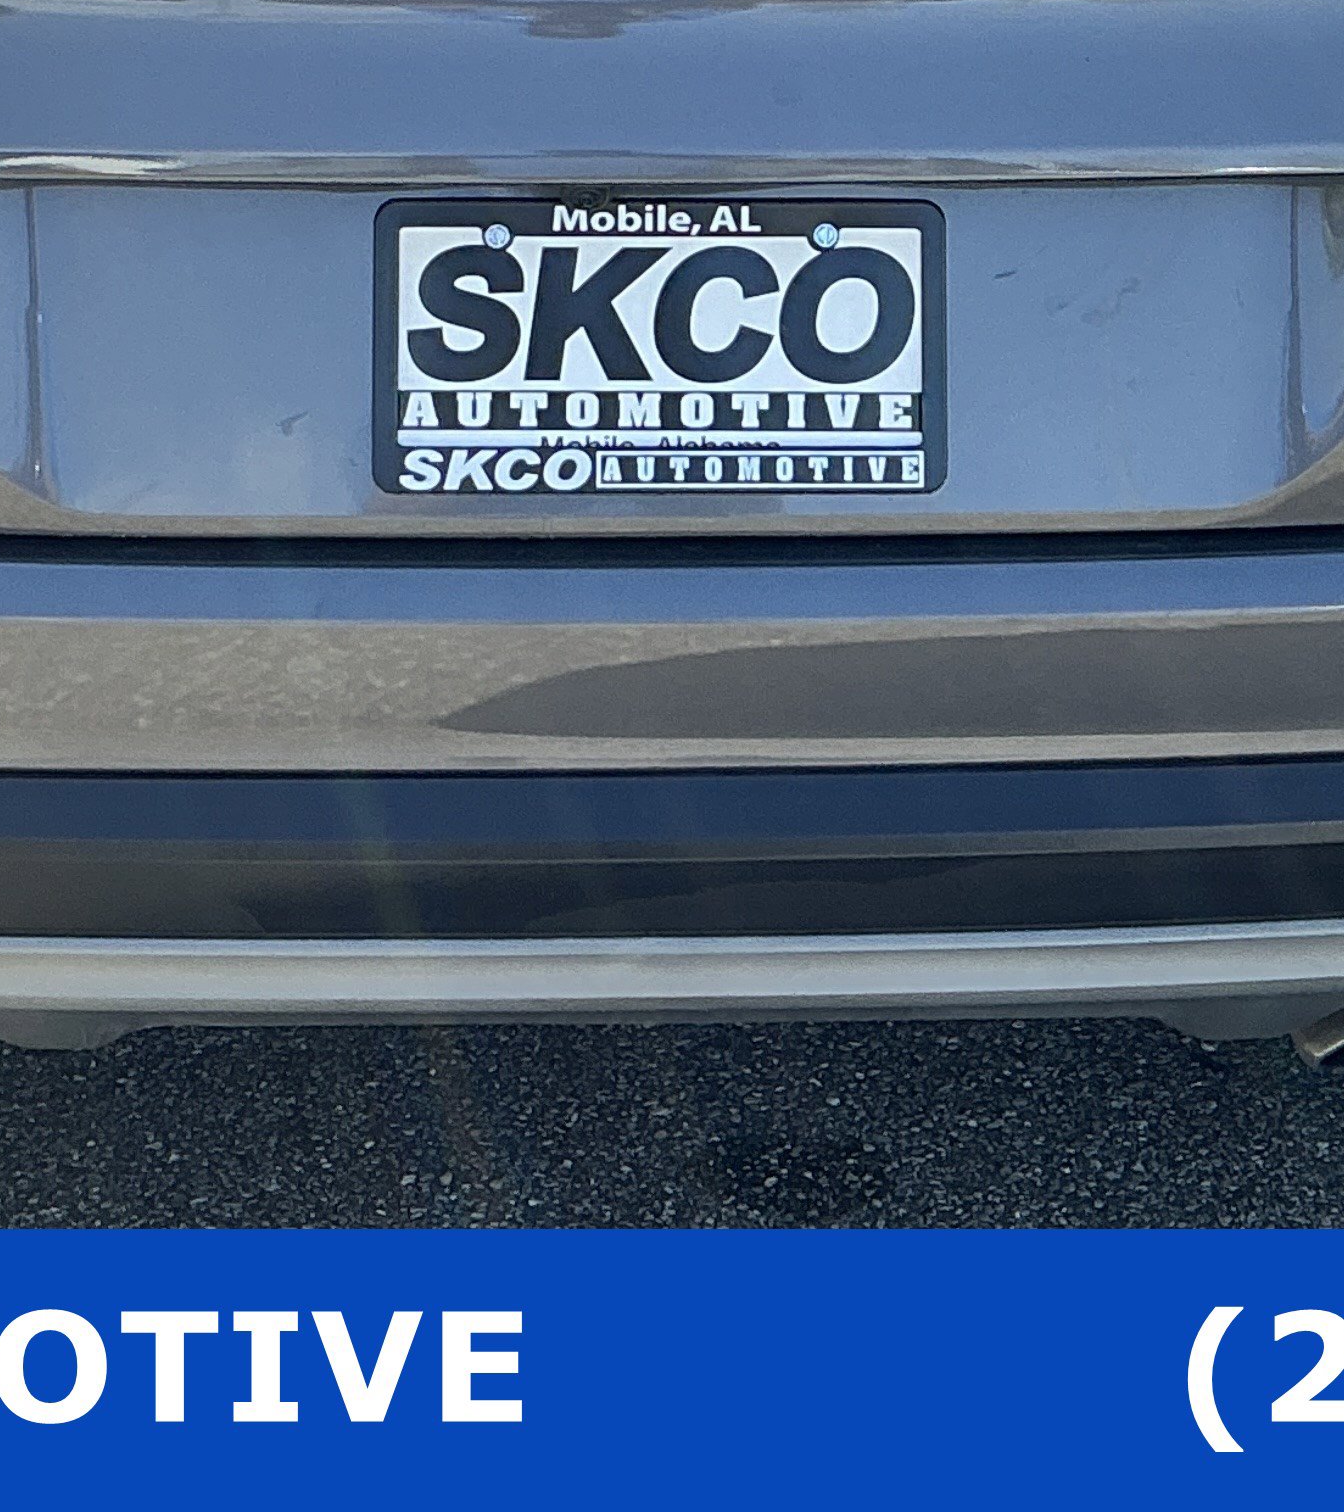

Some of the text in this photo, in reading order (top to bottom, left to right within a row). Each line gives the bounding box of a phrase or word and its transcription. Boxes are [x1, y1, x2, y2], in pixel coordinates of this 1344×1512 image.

[552, 203, 762, 236] Mobile, AL
[406, 244, 916, 385] SKCO
[402, 391, 913, 428] AUTOMOTIVE
[398, 448, 920, 491] SKCO AUTOMOTIVE
